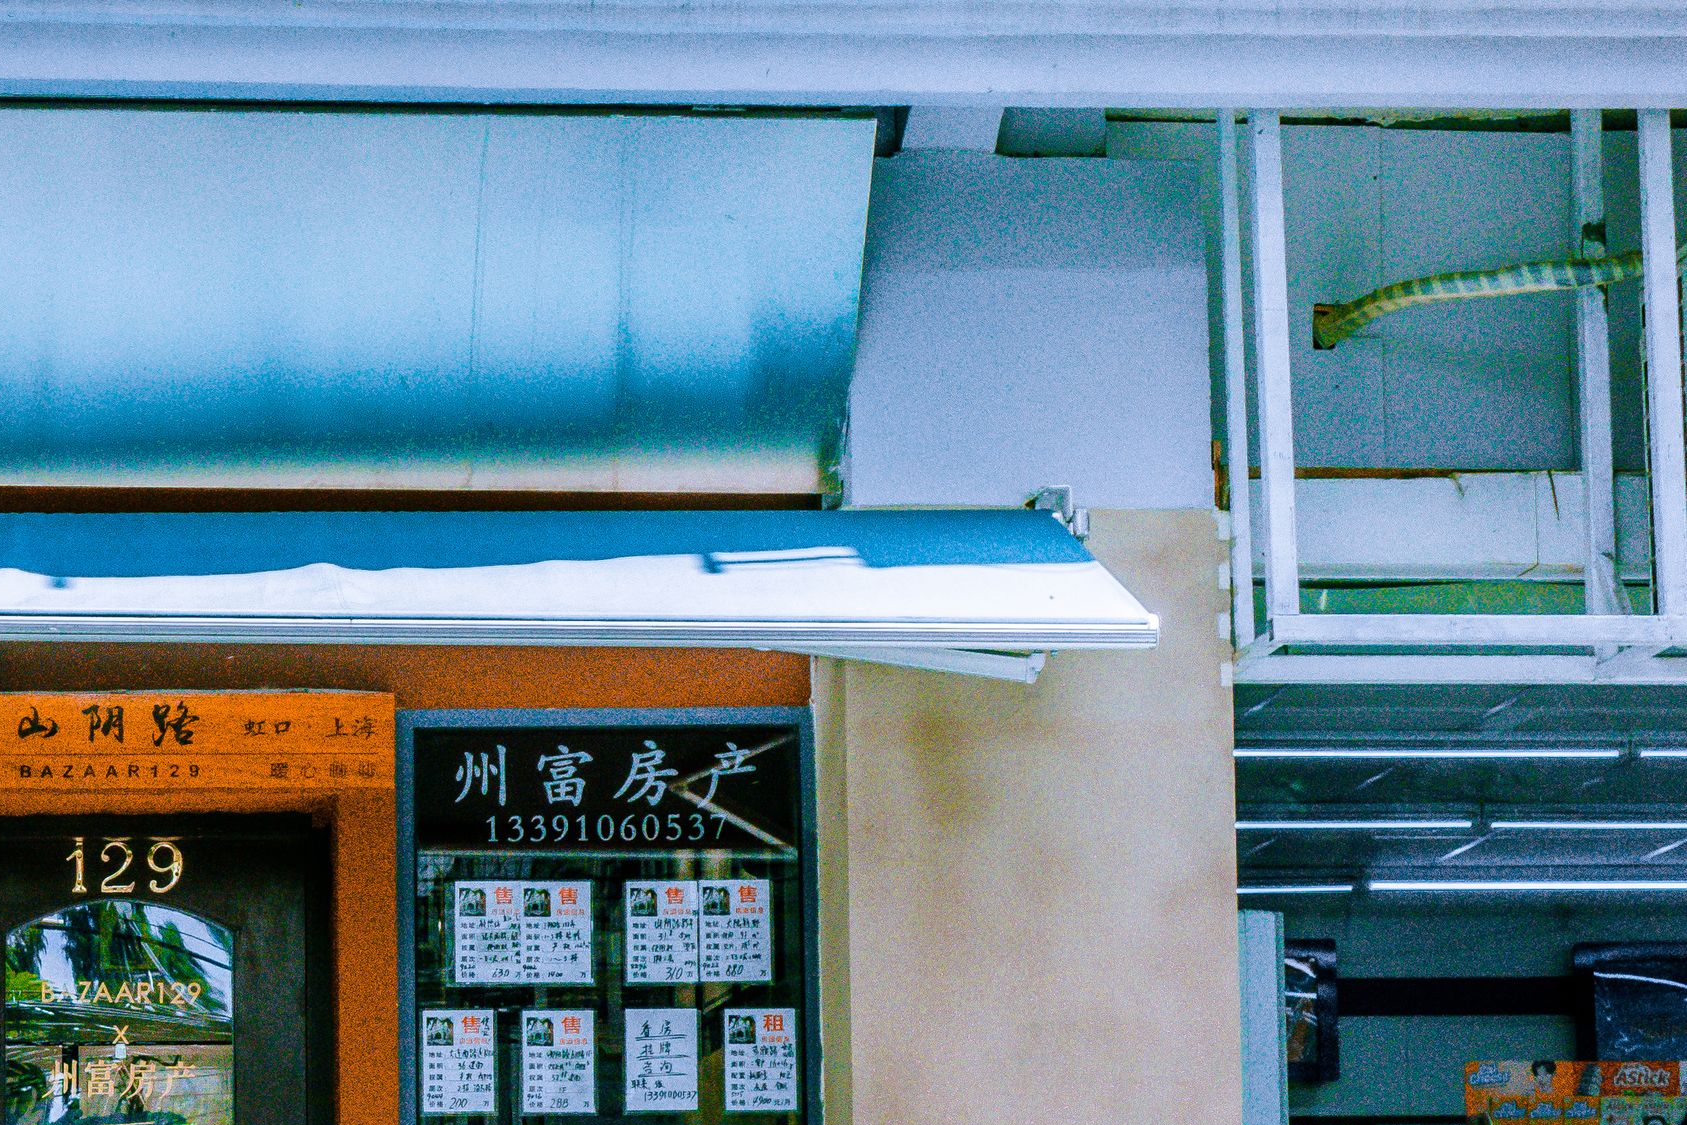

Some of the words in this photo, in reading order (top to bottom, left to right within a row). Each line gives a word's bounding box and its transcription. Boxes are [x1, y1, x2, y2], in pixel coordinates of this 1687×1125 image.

[17, 701, 201, 748] 山阴路
[243, 718, 293, 737] 虹口
[324, 715, 378, 740] 上海
[18, 763, 202, 780] BAZAAR129
[454, 739, 757, 808] 州富房产
[486, 813, 731, 842] 13391060537
[65, 840, 185, 893] 129
[494, 887, 512, 904] 售
[559, 887, 578, 905] 售
[665, 887, 685, 904] 售
[738, 885, 757, 902] 售
[665, 967, 683, 980] 310
[40, 981, 202, 1005] BAZAAR129
[462, 1015, 480, 1033] 售
[561, 1016, 581, 1034] 售
[763, 1014, 785, 1031] 租
[41, 1060, 197, 1099] 州富房产
